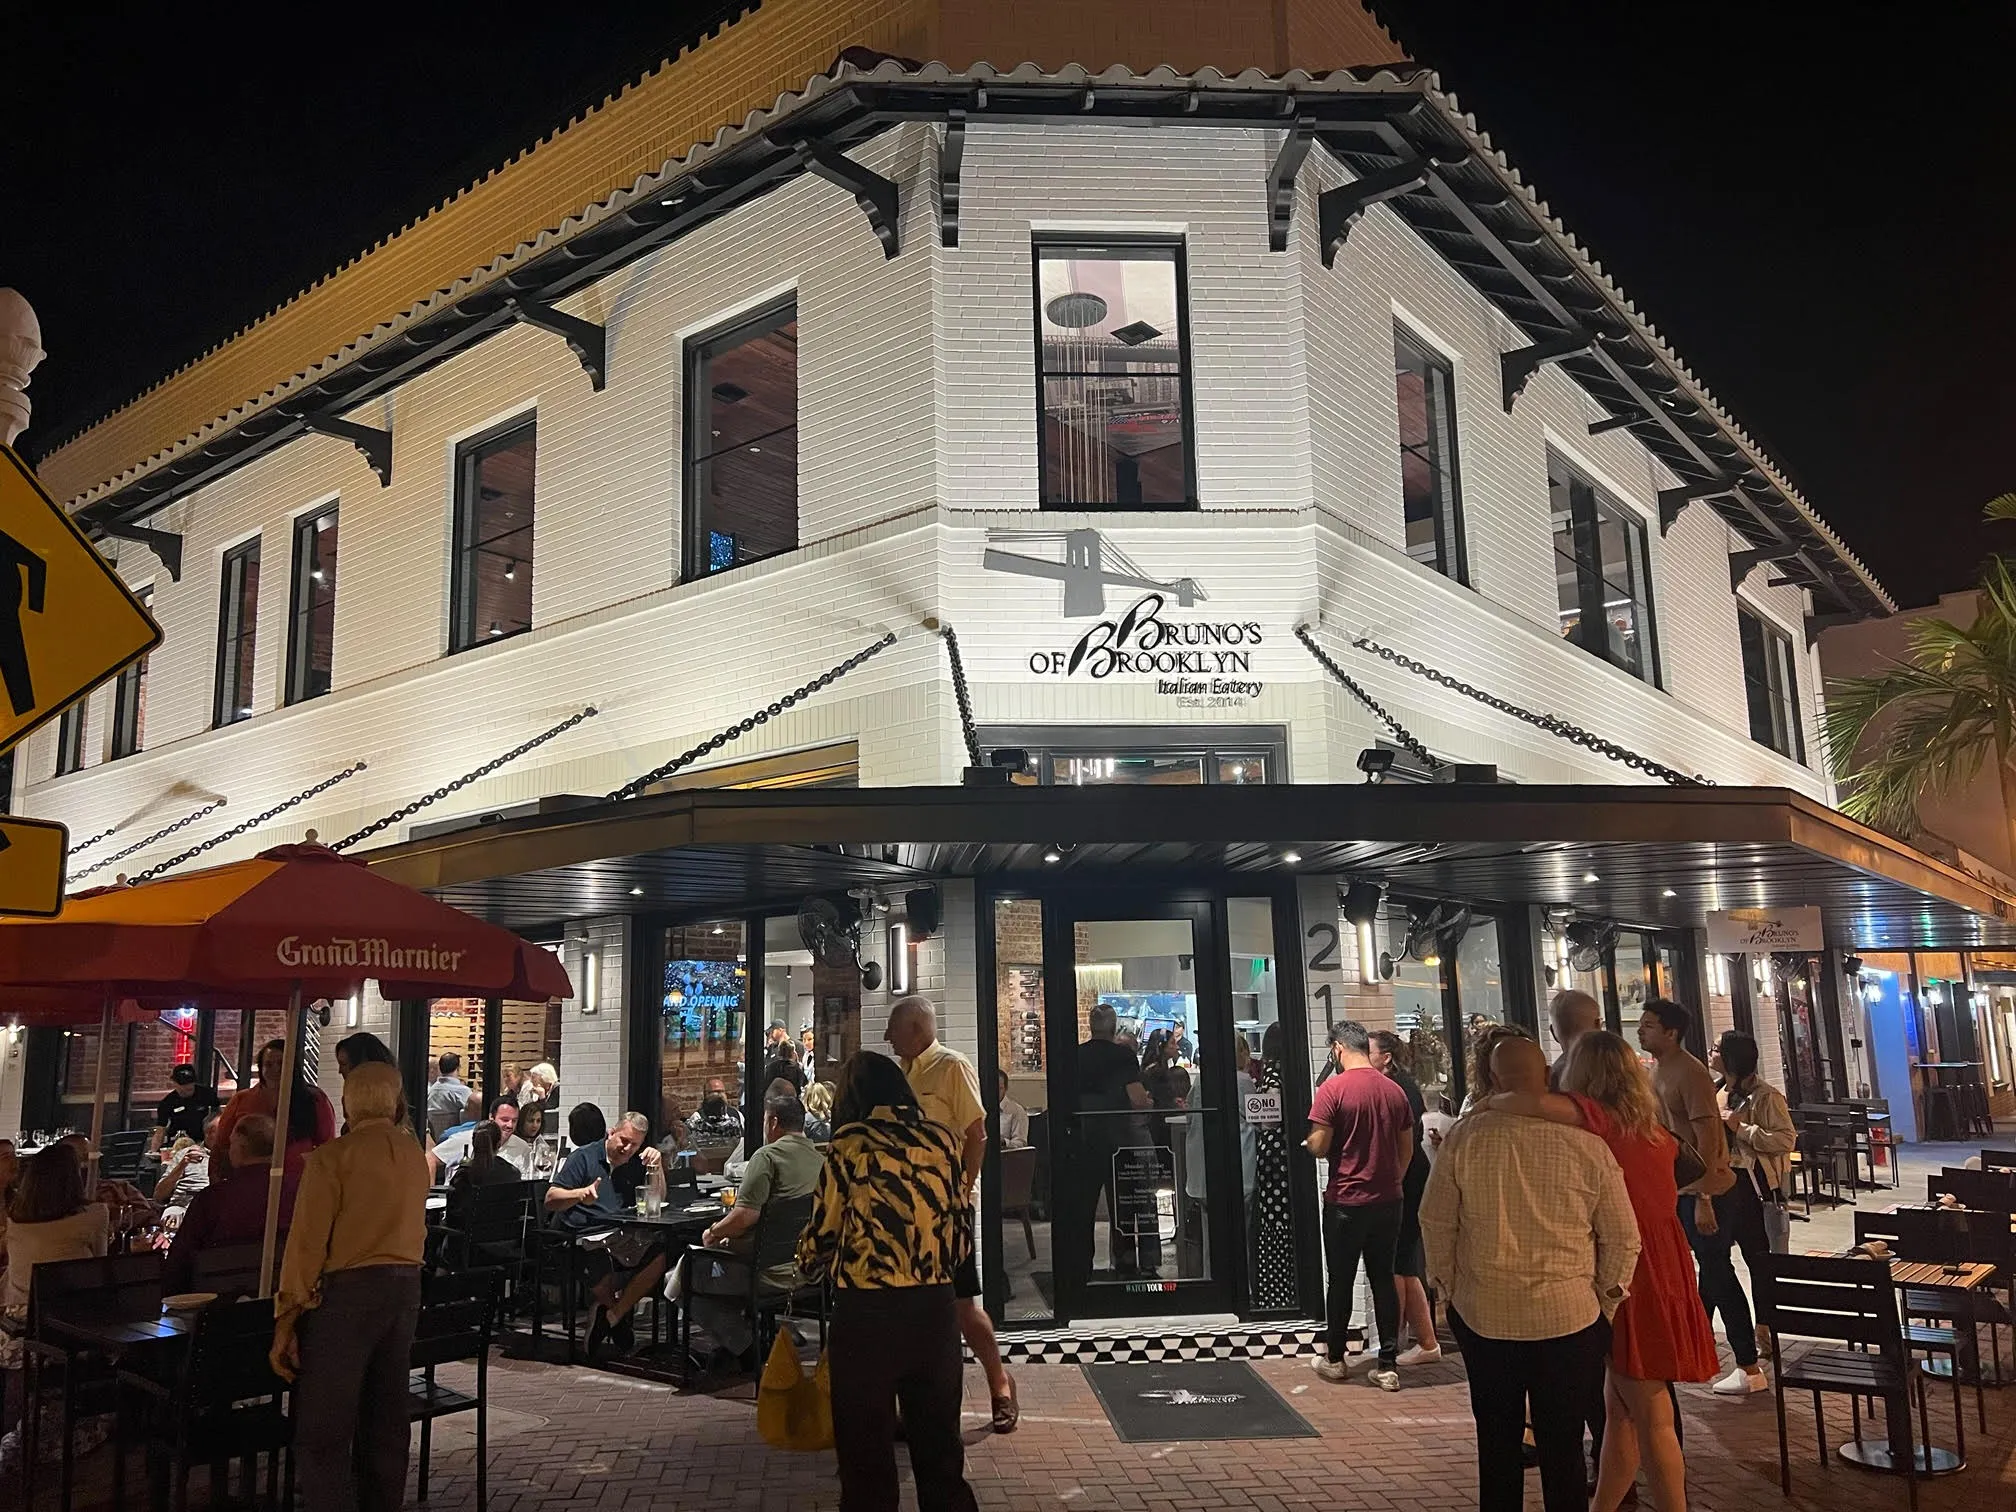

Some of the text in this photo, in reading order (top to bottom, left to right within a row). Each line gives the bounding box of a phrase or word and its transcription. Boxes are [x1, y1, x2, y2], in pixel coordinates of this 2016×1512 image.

[1117, 592, 1263, 651] BRUNO'S
[1029, 620, 1252, 679] OF BROOKLYN
[1158, 677, 1264, 698] Italian Eatery
[276, 935, 463, 972] Grand Marnier
[690, 994, 738, 1008] OPENING
[1262, 1098, 1275, 1107] NO
[1146, 1283, 1163, 1292] YOUR
